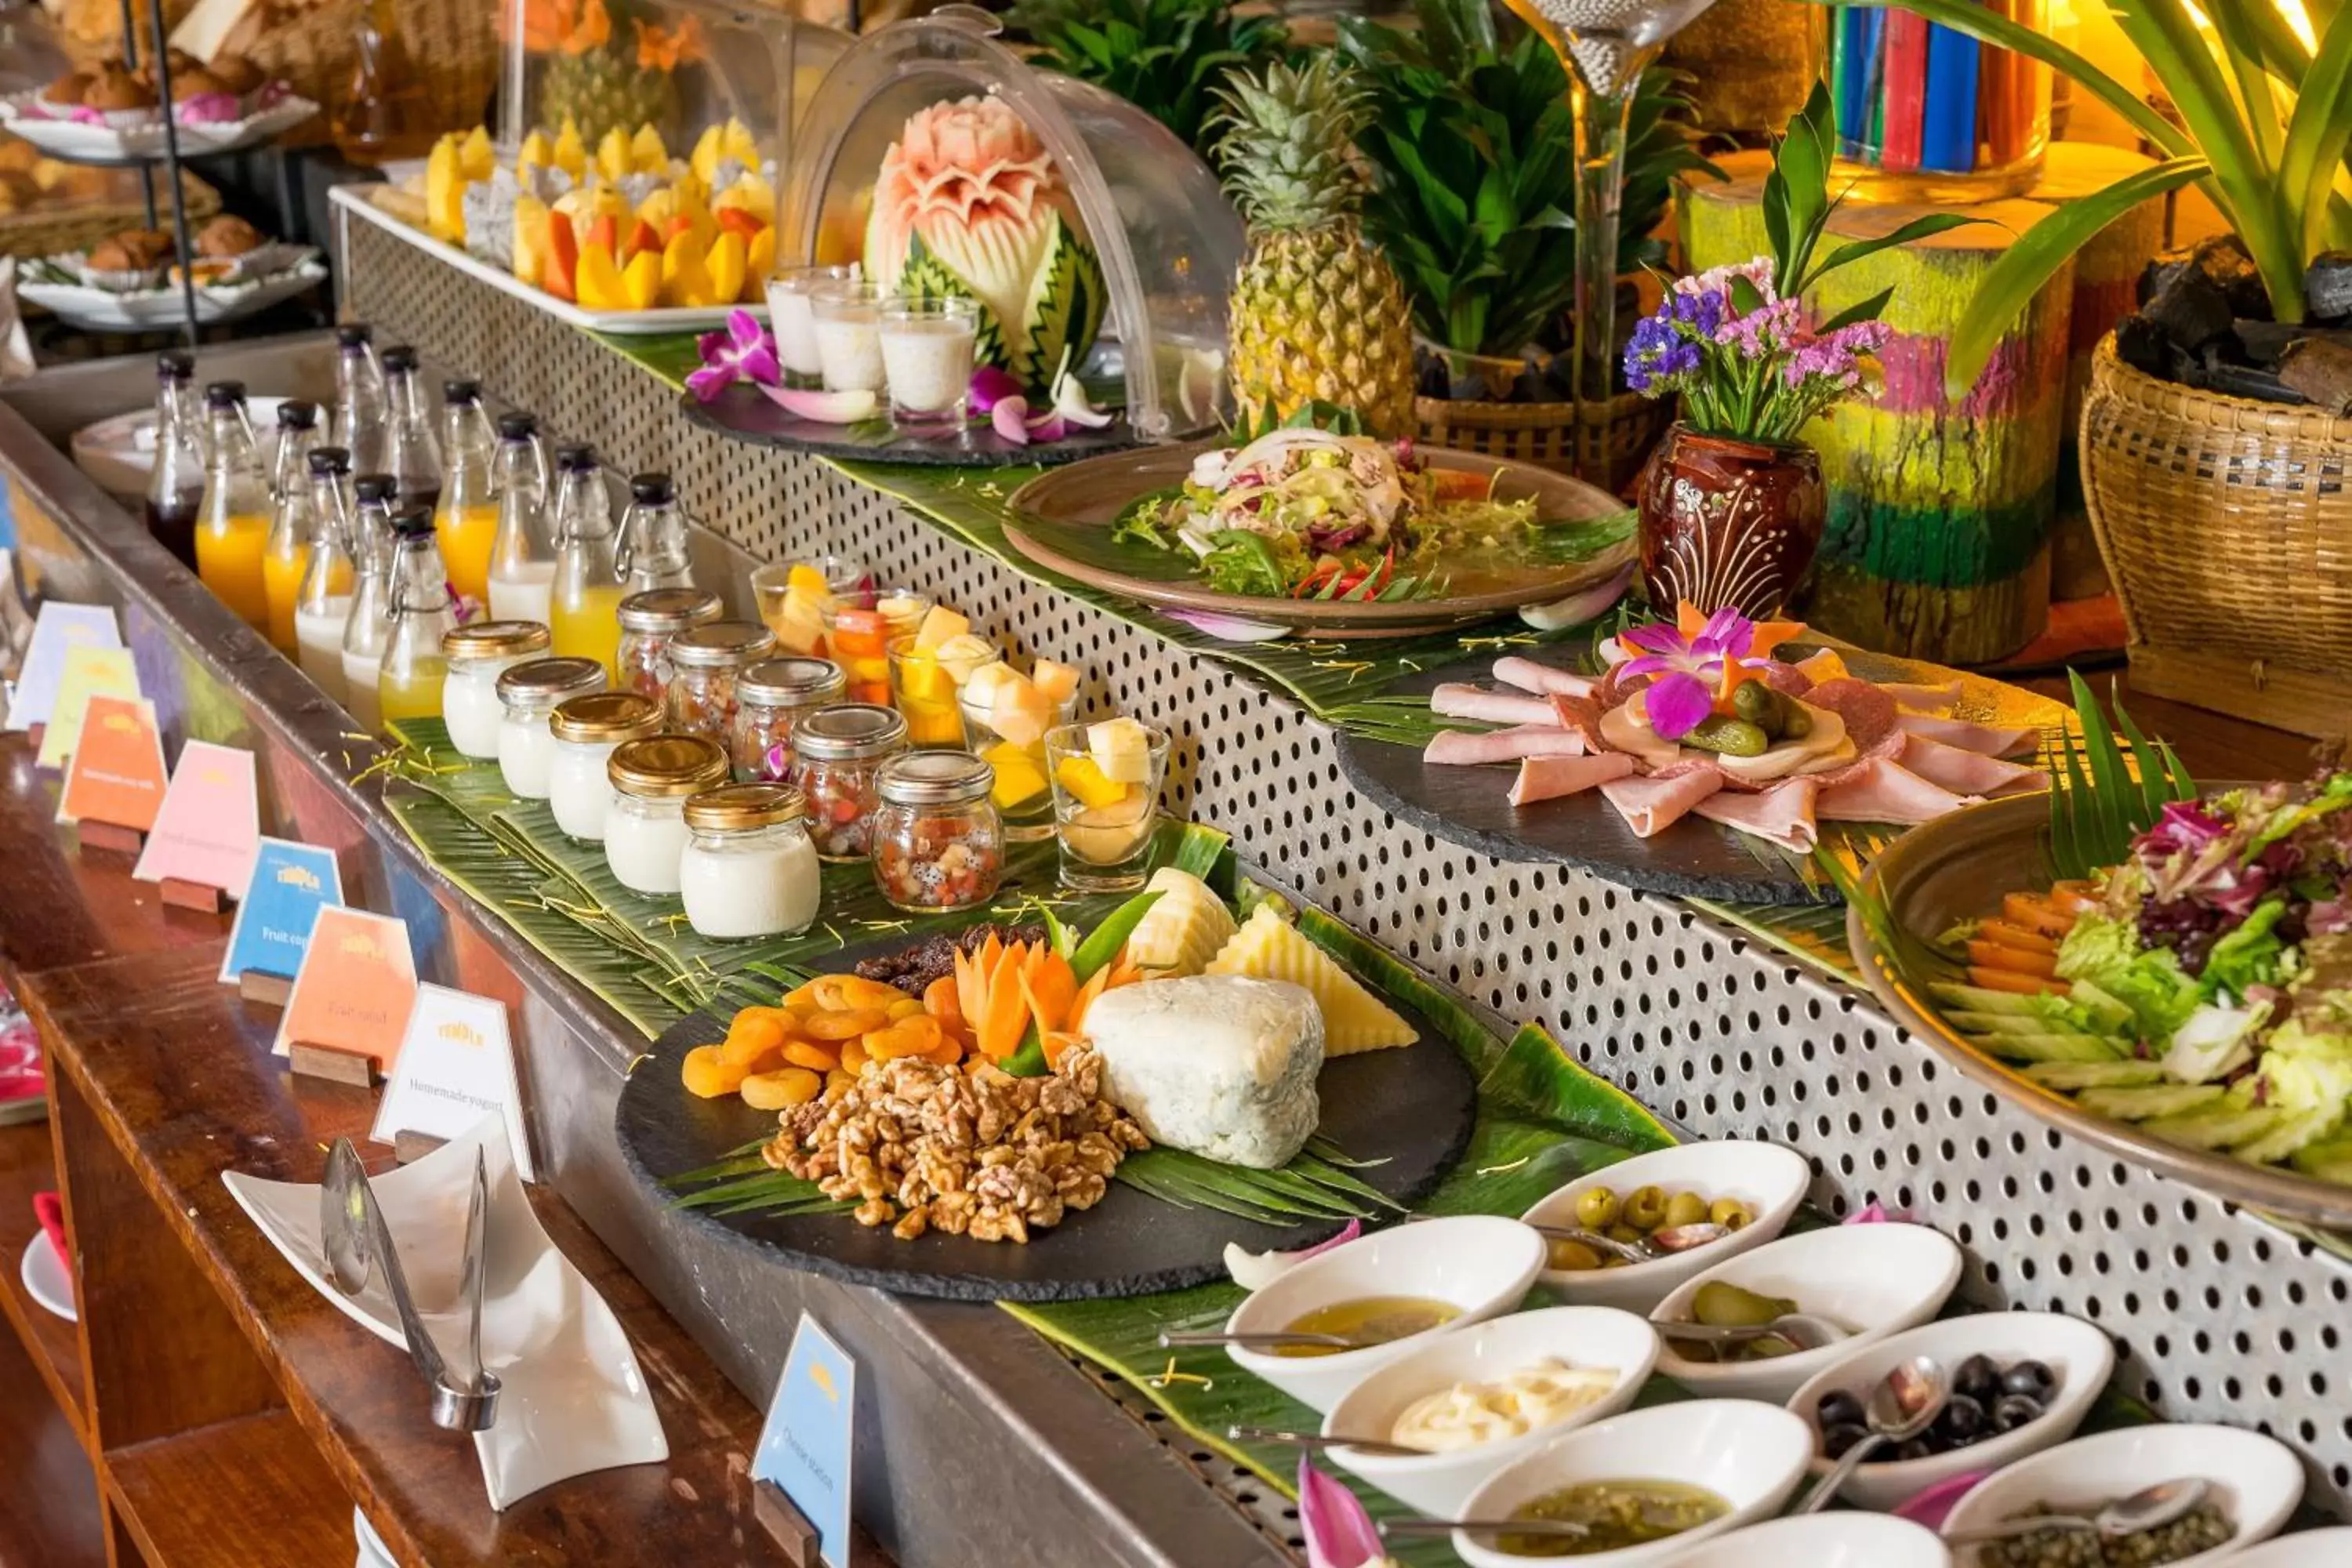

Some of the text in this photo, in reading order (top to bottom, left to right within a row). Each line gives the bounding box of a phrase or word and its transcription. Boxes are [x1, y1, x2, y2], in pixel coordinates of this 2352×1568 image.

[263, 926, 289, 943] Fruit
[410, 1078, 503, 1112] Homemade yogurt
